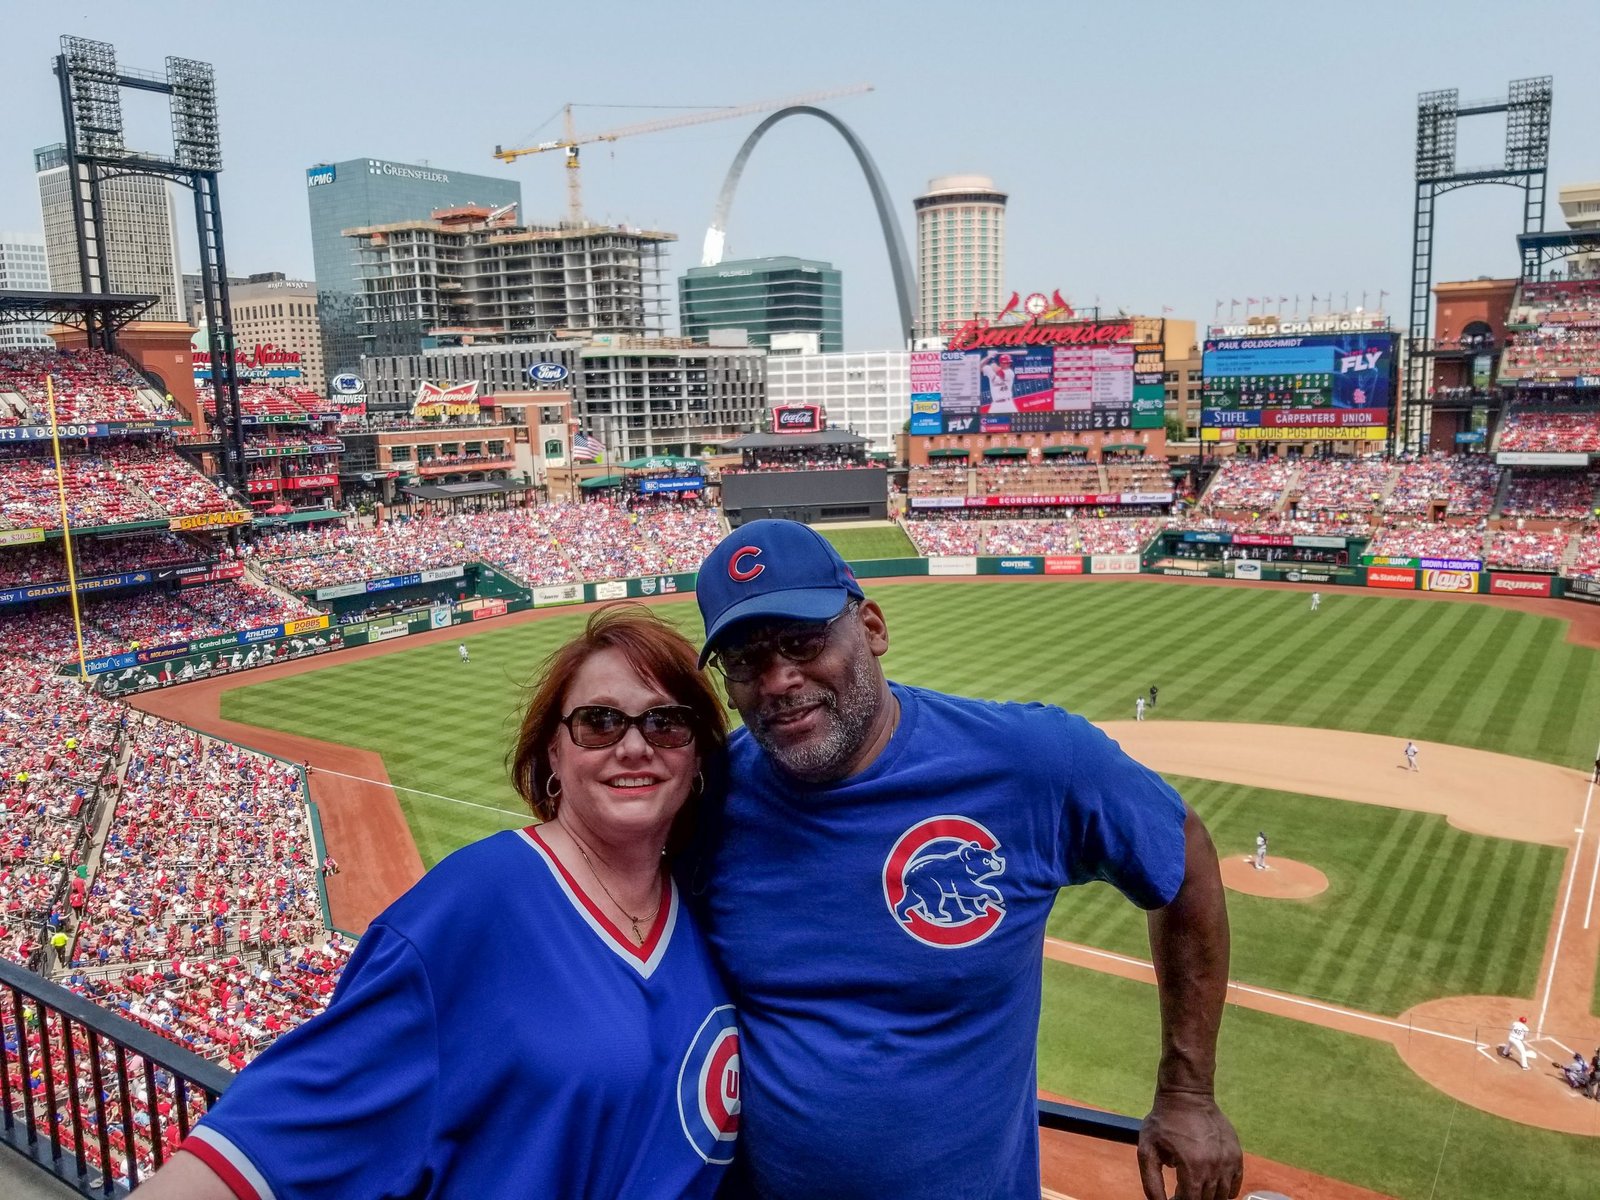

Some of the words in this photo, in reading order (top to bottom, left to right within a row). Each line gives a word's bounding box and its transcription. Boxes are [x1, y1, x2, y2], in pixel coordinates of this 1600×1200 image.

[308, 172, 333, 187] KPMG
[382, 163, 450, 184] GREENSFELDER
[948, 317, 1134, 350] Budweiser
[1223, 324, 1276, 336] WORLD
[1279, 321, 1373, 334] CHAMPIONS
[1218, 342, 1239, 350] PAUL
[1241, 338, 1304, 349] GOLDSCHMIDT
[246, 343, 301, 368] Nation
[911, 353, 940, 362] KMOX
[942, 352, 965, 360] CUBS
[1341, 351, 1383, 374] FLY
[538, 365, 561, 379] Ford
[911, 382, 940, 392] NEWS
[332, 394, 367, 404] MIDWEST
[415, 387, 478, 404] Budweiser
[415, 405, 442, 417] BREW
[446, 404, 480, 416] HOUSE
[780, 411, 813, 424] Coca-Cola
[1094, 417, 1102, 428] 2
[1107, 416, 1115, 427] 2
[1121, 416, 1129, 427] 0
[1214, 411, 1249, 423] STIFEL
[1275, 412, 1336, 424] CARPENTERS
[1342, 412, 1372, 423] UNION
[948, 418, 973, 433] FLY
[1255, 428, 1283, 438] LOUIS
[998, 496, 1056, 504] SCOREBOARD
[1059, 495, 1086, 503] PATIO
[180, 515, 207, 530] BIG
[208, 511, 244, 525] MAC
[728, 545, 766, 582] C
[1373, 556, 1412, 565] SUBWAY
[1421, 559, 1443, 568] BROWN
[434, 570, 457, 579] Ballpark
[1164, 568, 1182, 576] BUSCH
[1183, 569, 1208, 578] STADIUM
[1302, 573, 1329, 582] MIDWEST
[27, 577, 121, 597] GRAD.WESTER.EDU
[1494, 579, 1546, 591] EQUIFAX
[294, 618, 320, 629] DOBBS
[245, 627, 279, 640] ATHLETICO
[199, 639, 221, 649] Central
[222, 635, 238, 646] Bank
